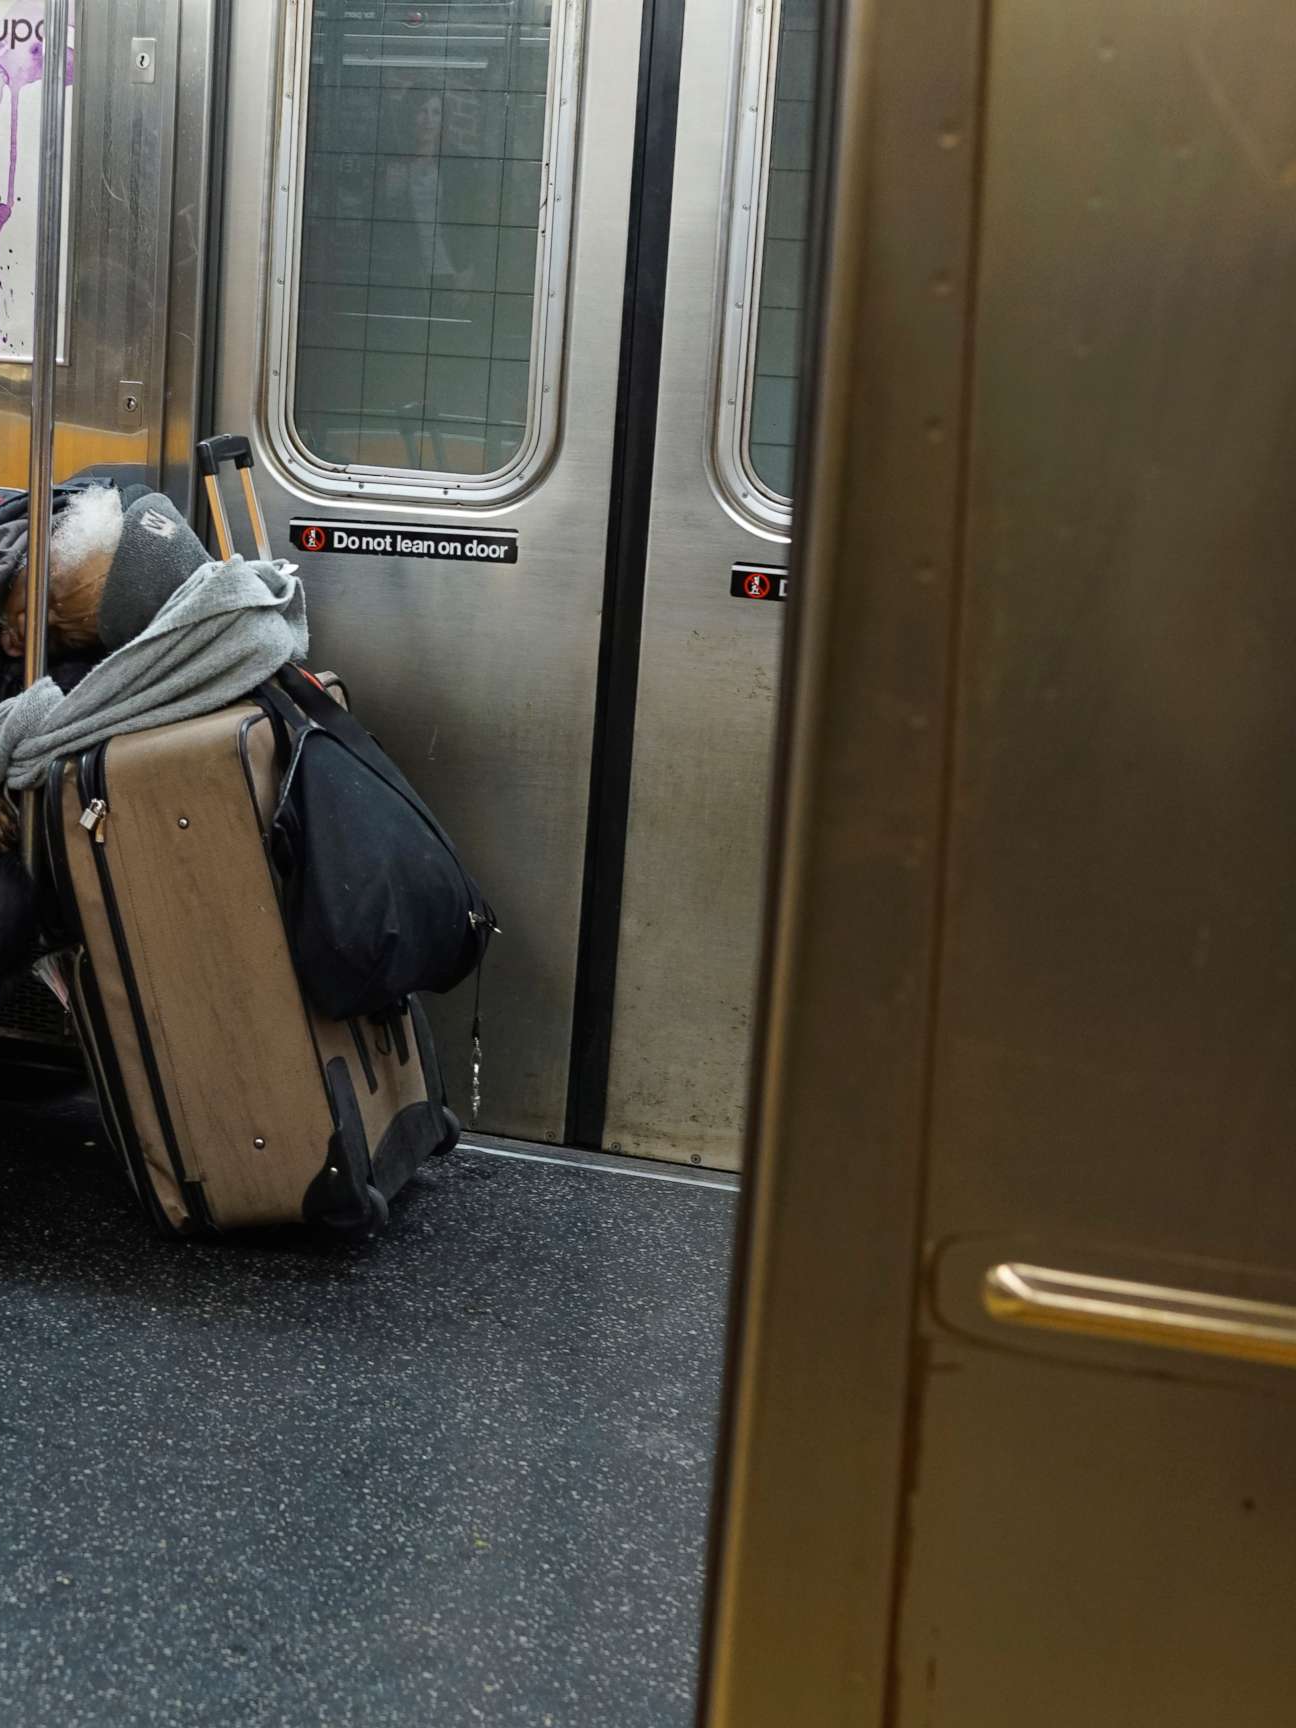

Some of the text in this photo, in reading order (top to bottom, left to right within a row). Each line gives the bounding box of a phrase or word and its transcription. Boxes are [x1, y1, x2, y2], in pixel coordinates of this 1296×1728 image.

[333, 531, 509, 559] Do not lean on door
